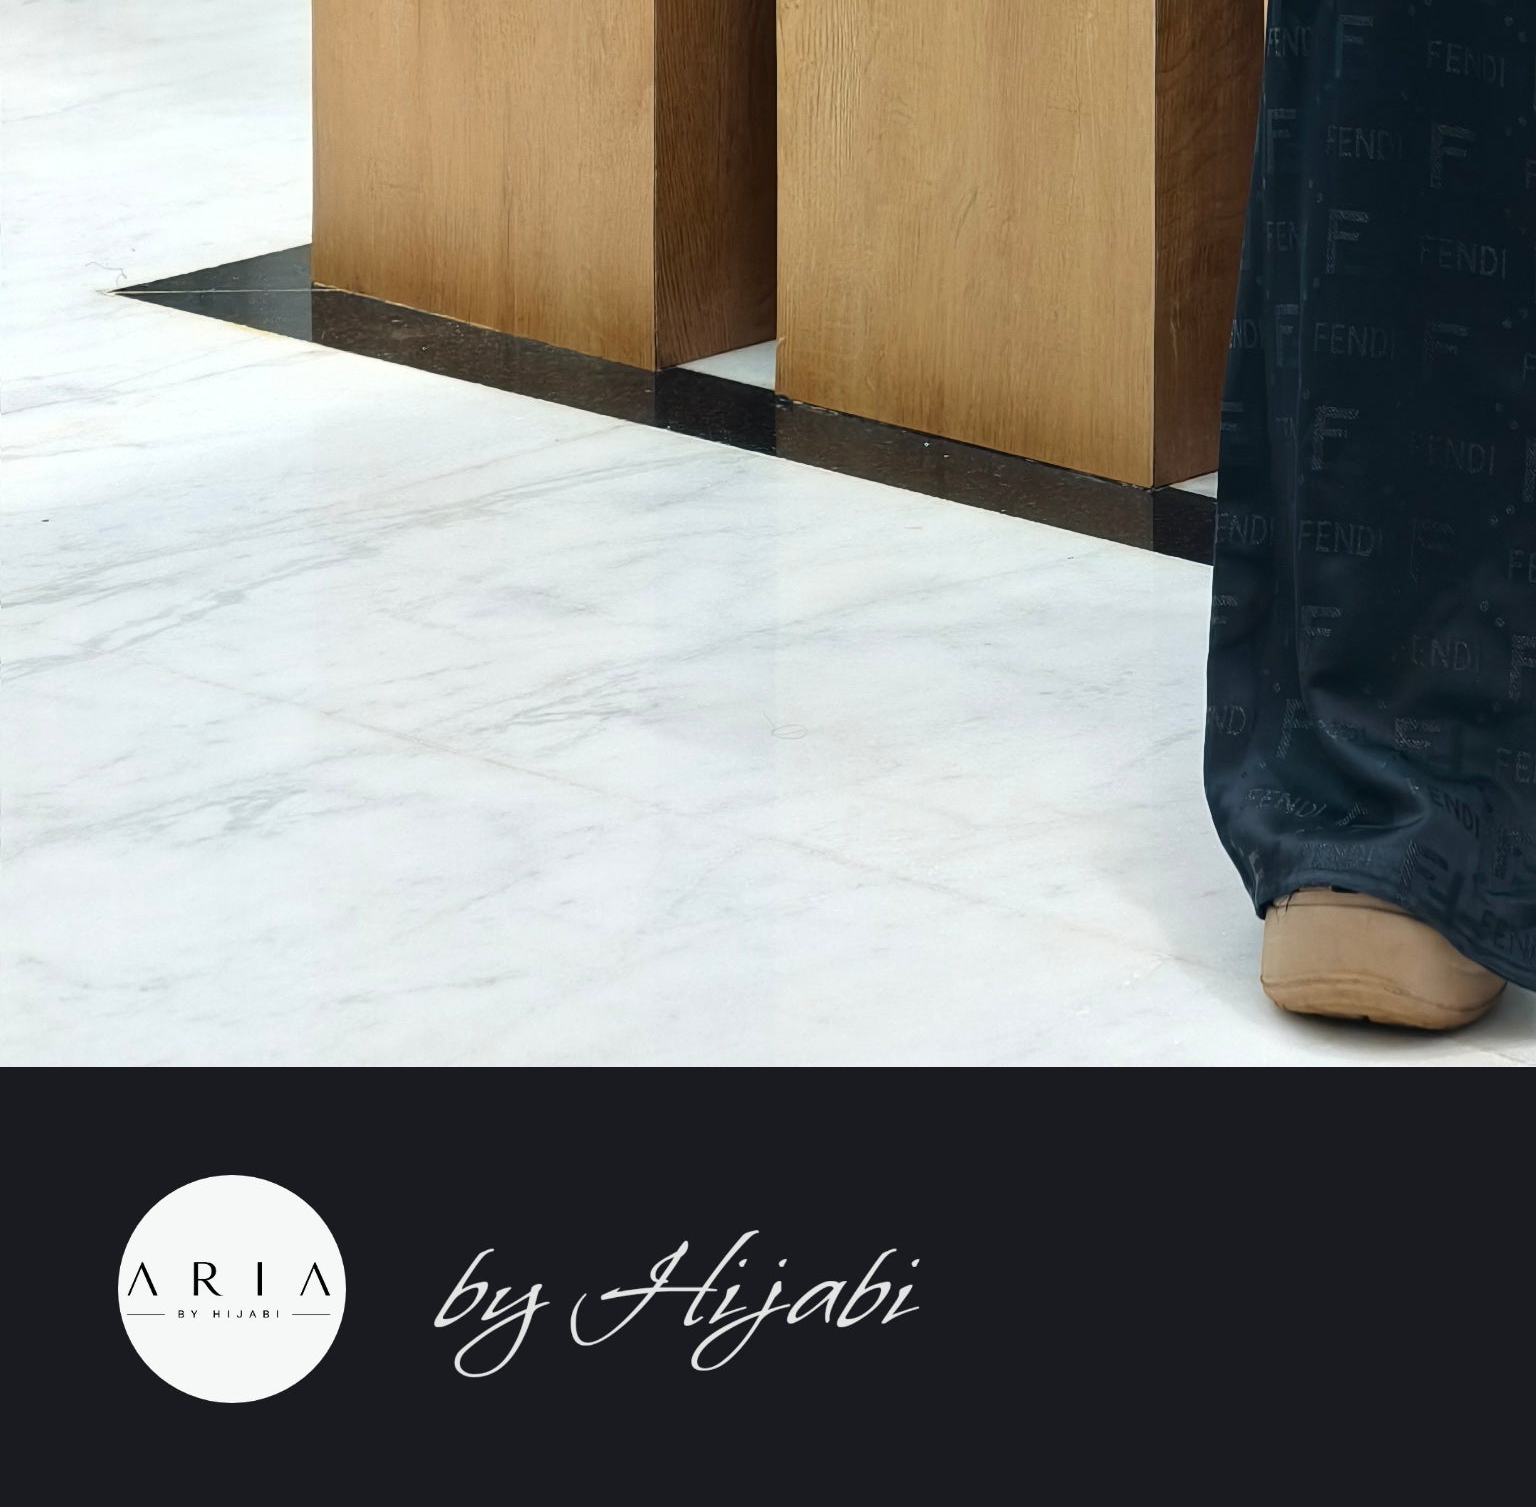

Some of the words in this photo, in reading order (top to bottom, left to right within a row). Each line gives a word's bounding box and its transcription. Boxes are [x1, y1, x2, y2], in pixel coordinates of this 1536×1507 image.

[1334, 13, 1374, 78] F
[1426, 36, 1505, 89] FENDI
[1266, 108, 1297, 176] F
[1324, 124, 1401, 161] FENDI
[1430, 122, 1477, 189] F
[1325, 209, 1370, 275] F
[1313, 322, 1396, 360] FENDI
[1312, 404, 1360, 472] F
[1300, 519, 1383, 556] FENDI
[1431, 786, 1480, 838] ENDI
